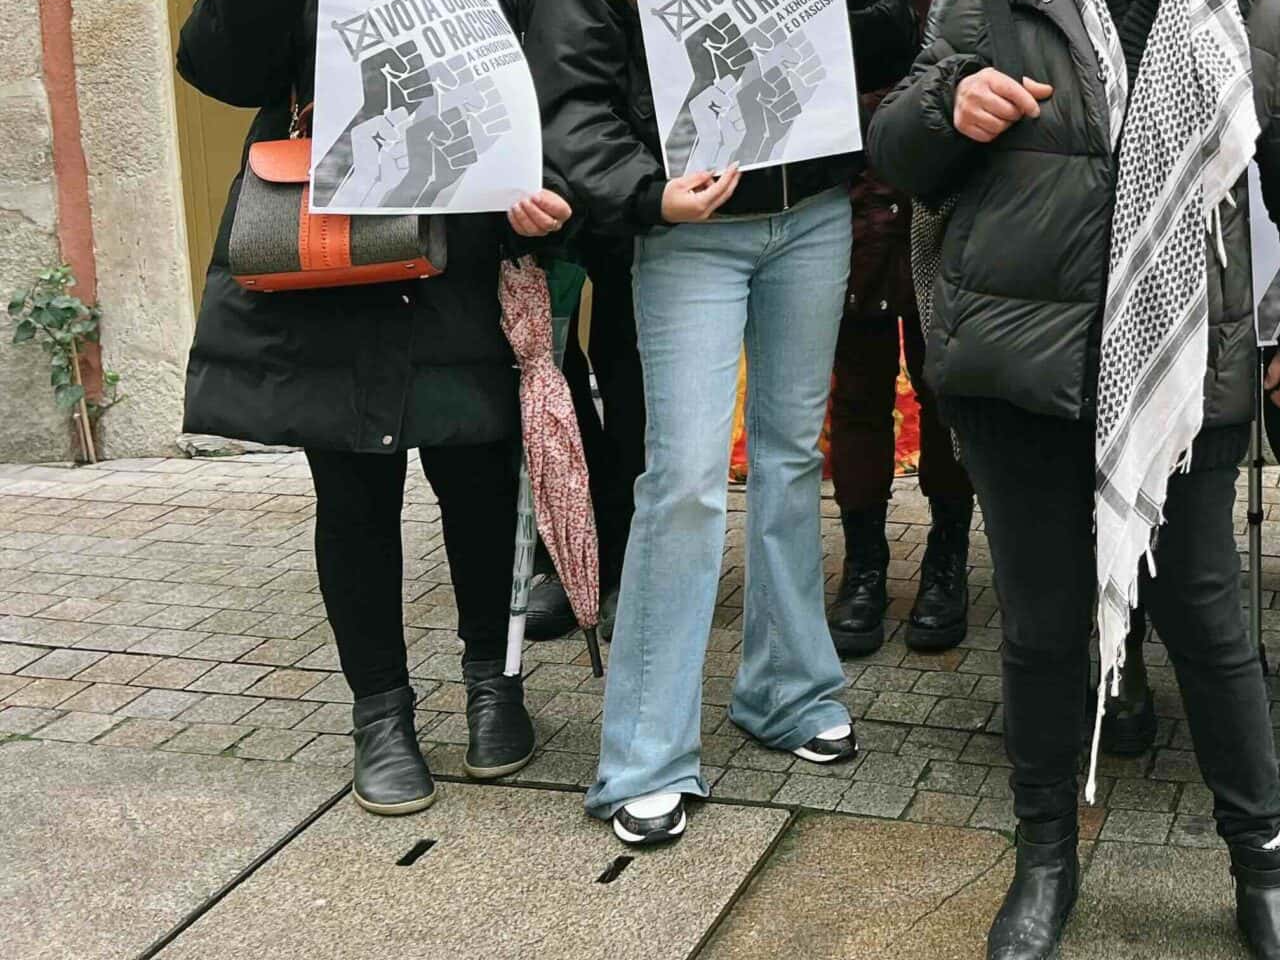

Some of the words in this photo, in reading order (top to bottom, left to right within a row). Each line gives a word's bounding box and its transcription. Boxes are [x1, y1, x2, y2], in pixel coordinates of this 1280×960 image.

[776, 11, 786, 22] A
[785, 23, 793, 34] E
[792, 17, 801, 28] O
[421, 25, 446, 58] O
[466, 51, 477, 62] A
[473, 65, 482, 76] E
[481, 61, 490, 73] O
